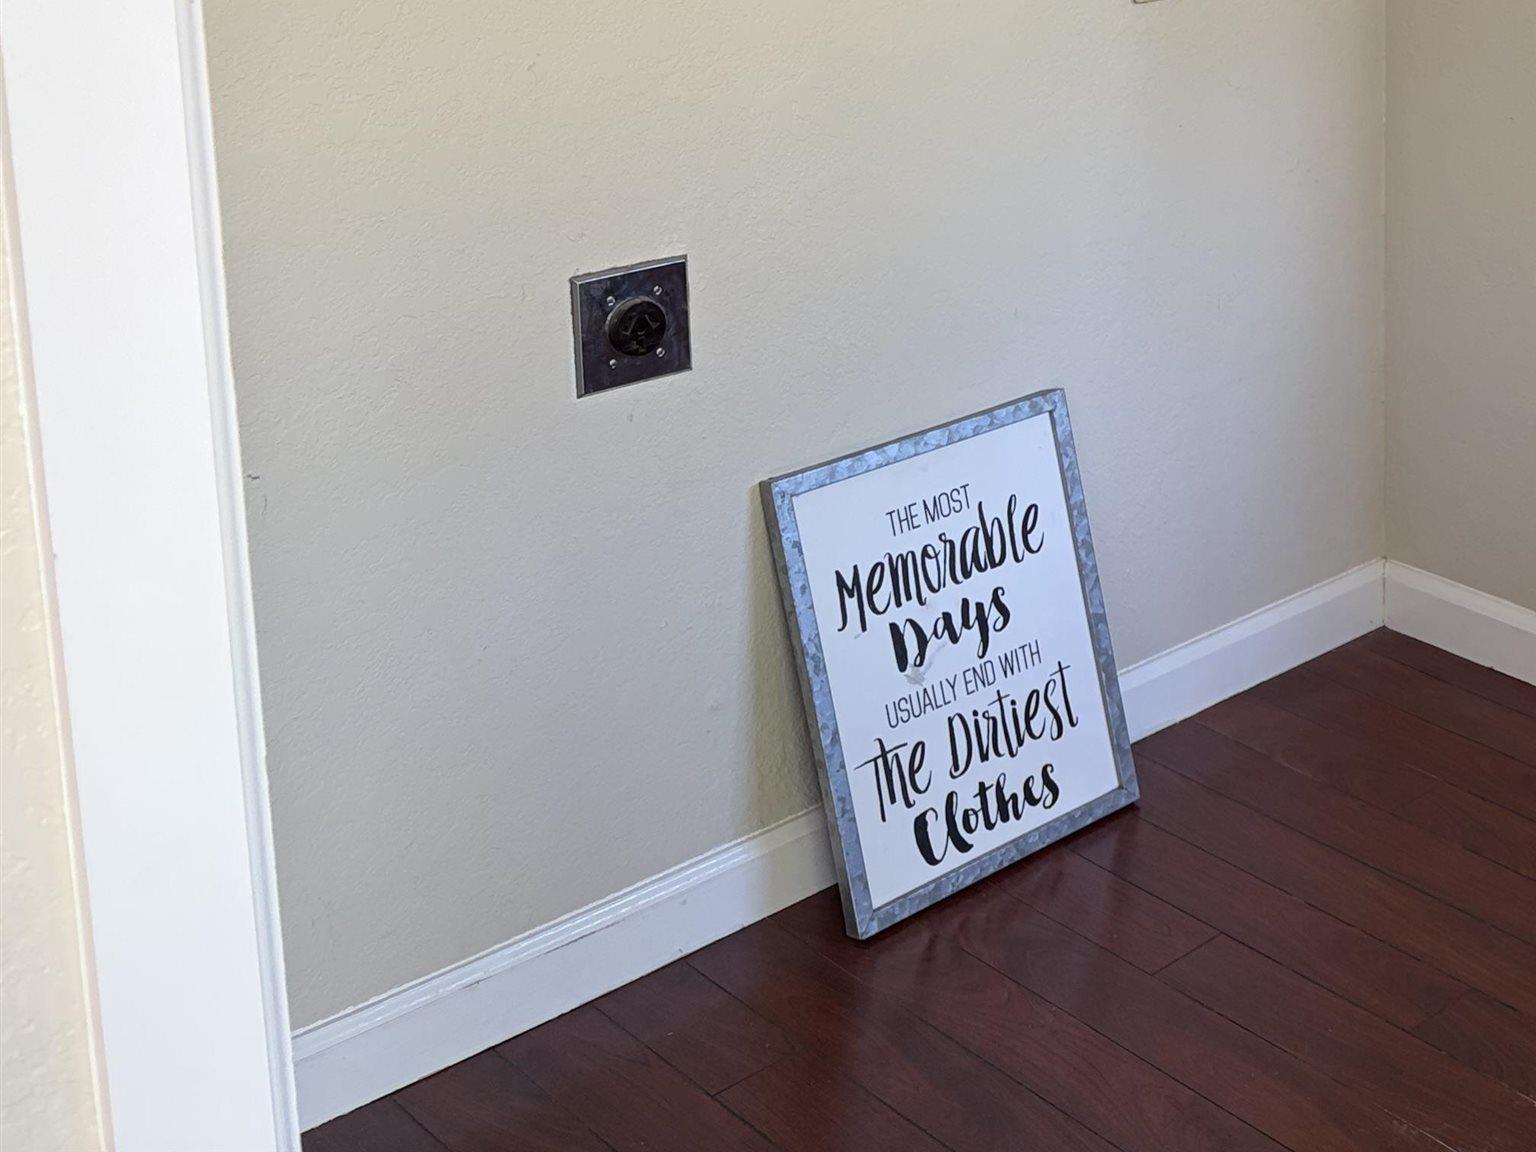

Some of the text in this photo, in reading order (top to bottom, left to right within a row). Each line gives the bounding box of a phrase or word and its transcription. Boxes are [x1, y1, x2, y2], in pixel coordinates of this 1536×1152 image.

[886, 484, 970, 536] THE MOST
[835, 494, 1044, 633] Memorable
[889, 586, 1011, 673] Days
[885, 640, 1042, 728] USUALLY END WITH
[948, 661, 1078, 779] Dirtiest
[914, 763, 1060, 866] Clothes
